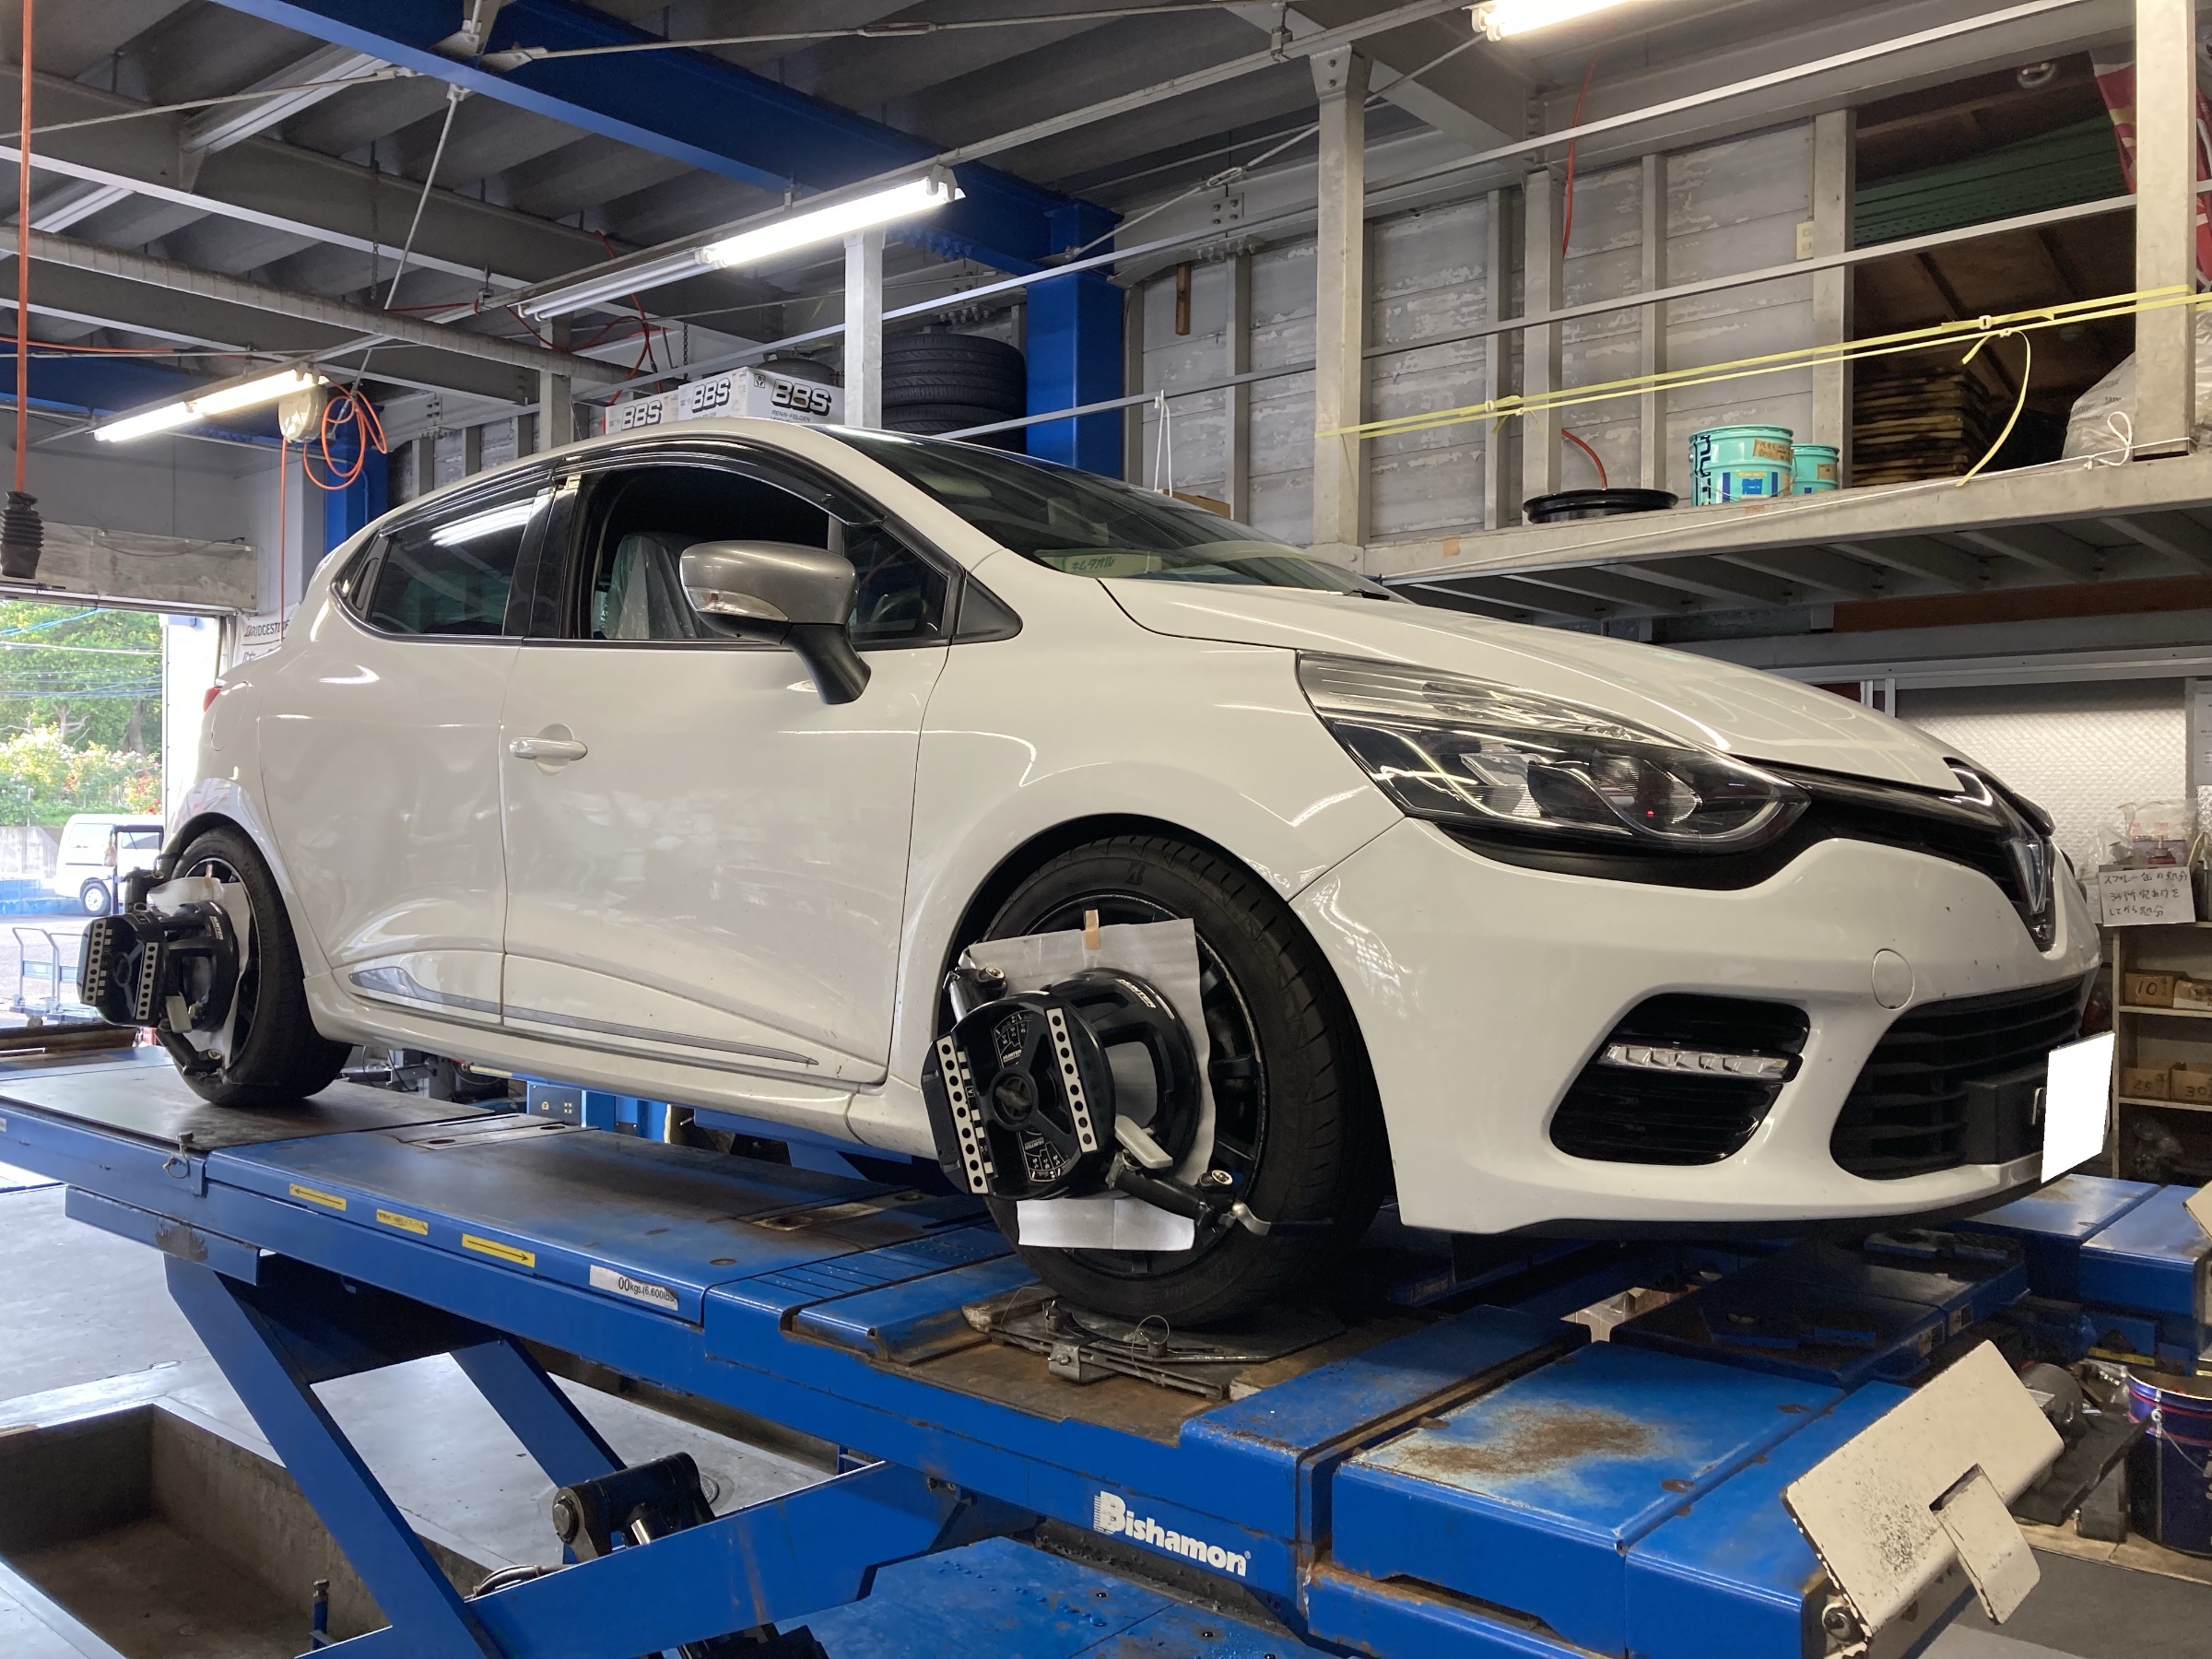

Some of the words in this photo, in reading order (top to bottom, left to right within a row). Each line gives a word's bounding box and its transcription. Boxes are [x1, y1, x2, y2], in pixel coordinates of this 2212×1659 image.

[692, 378, 731, 414] BBS
[771, 379, 831, 417] BBS
[621, 400, 662, 431] BBS
[771, 409, 811, 423] RENN-FELGEN
[1071, 556, 1115, 571] キムタオル
[1116, 979, 1157, 1009] HUNTER
[1002, 1049, 1022, 1060] HUNTER
[1093, 1490, 1247, 1578] Bishamon
